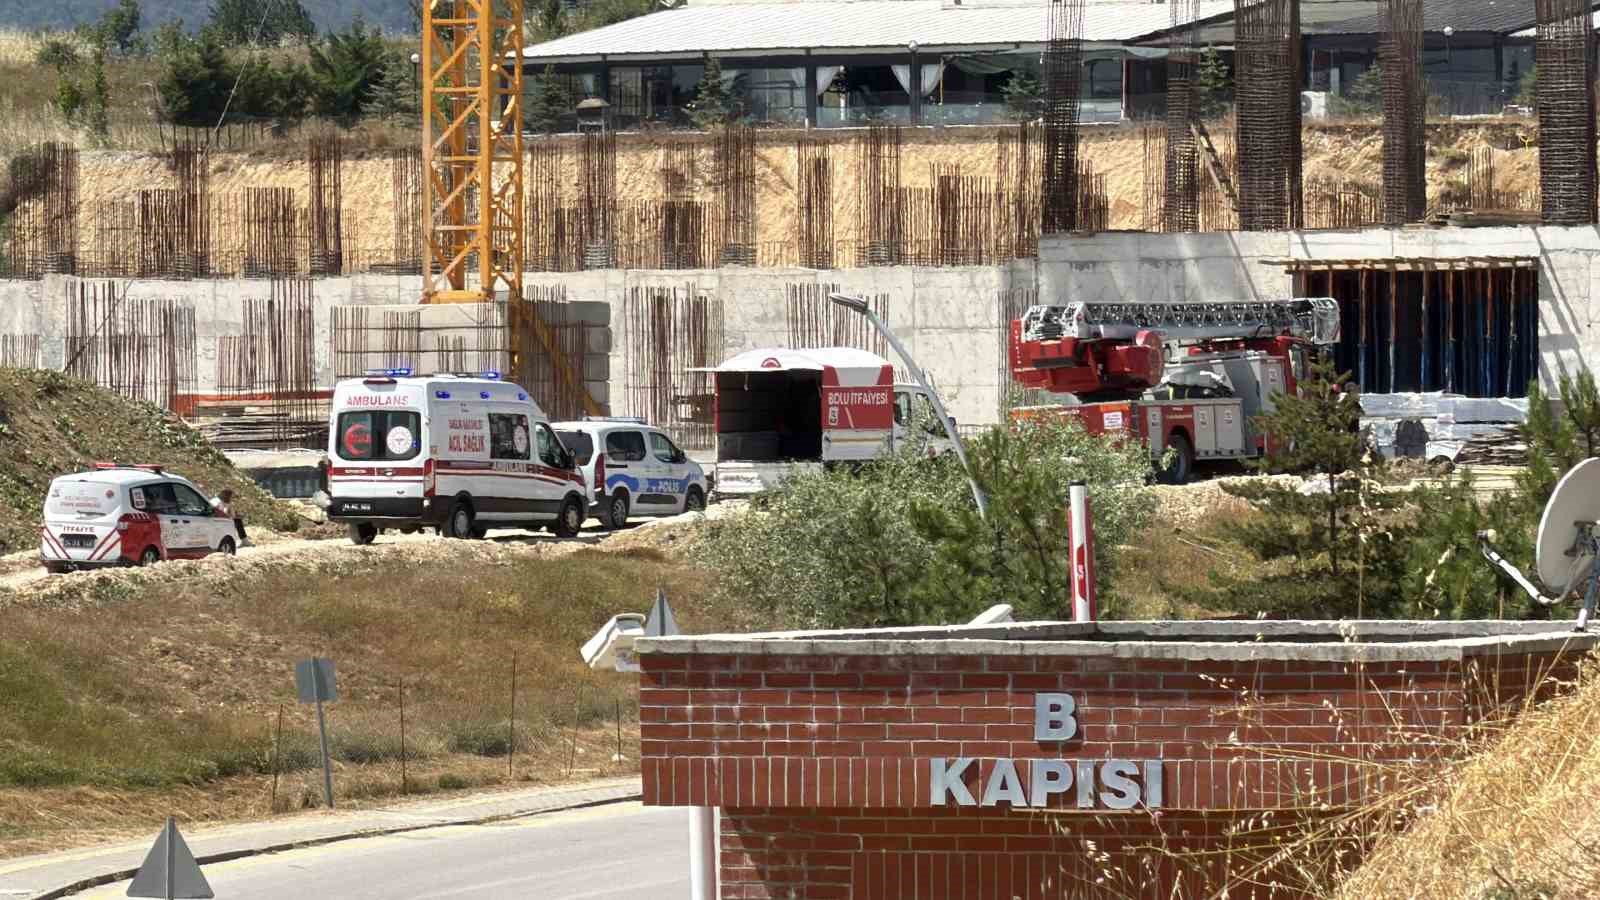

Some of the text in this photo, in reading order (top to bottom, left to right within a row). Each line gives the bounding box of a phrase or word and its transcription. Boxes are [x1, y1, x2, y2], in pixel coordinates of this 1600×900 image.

[346, 395, 409, 406] AMBULANS
[828, 392, 850, 406] BOLU
[1034, 692, 1078, 741] B
[930, 757, 1163, 809] KAPISI
